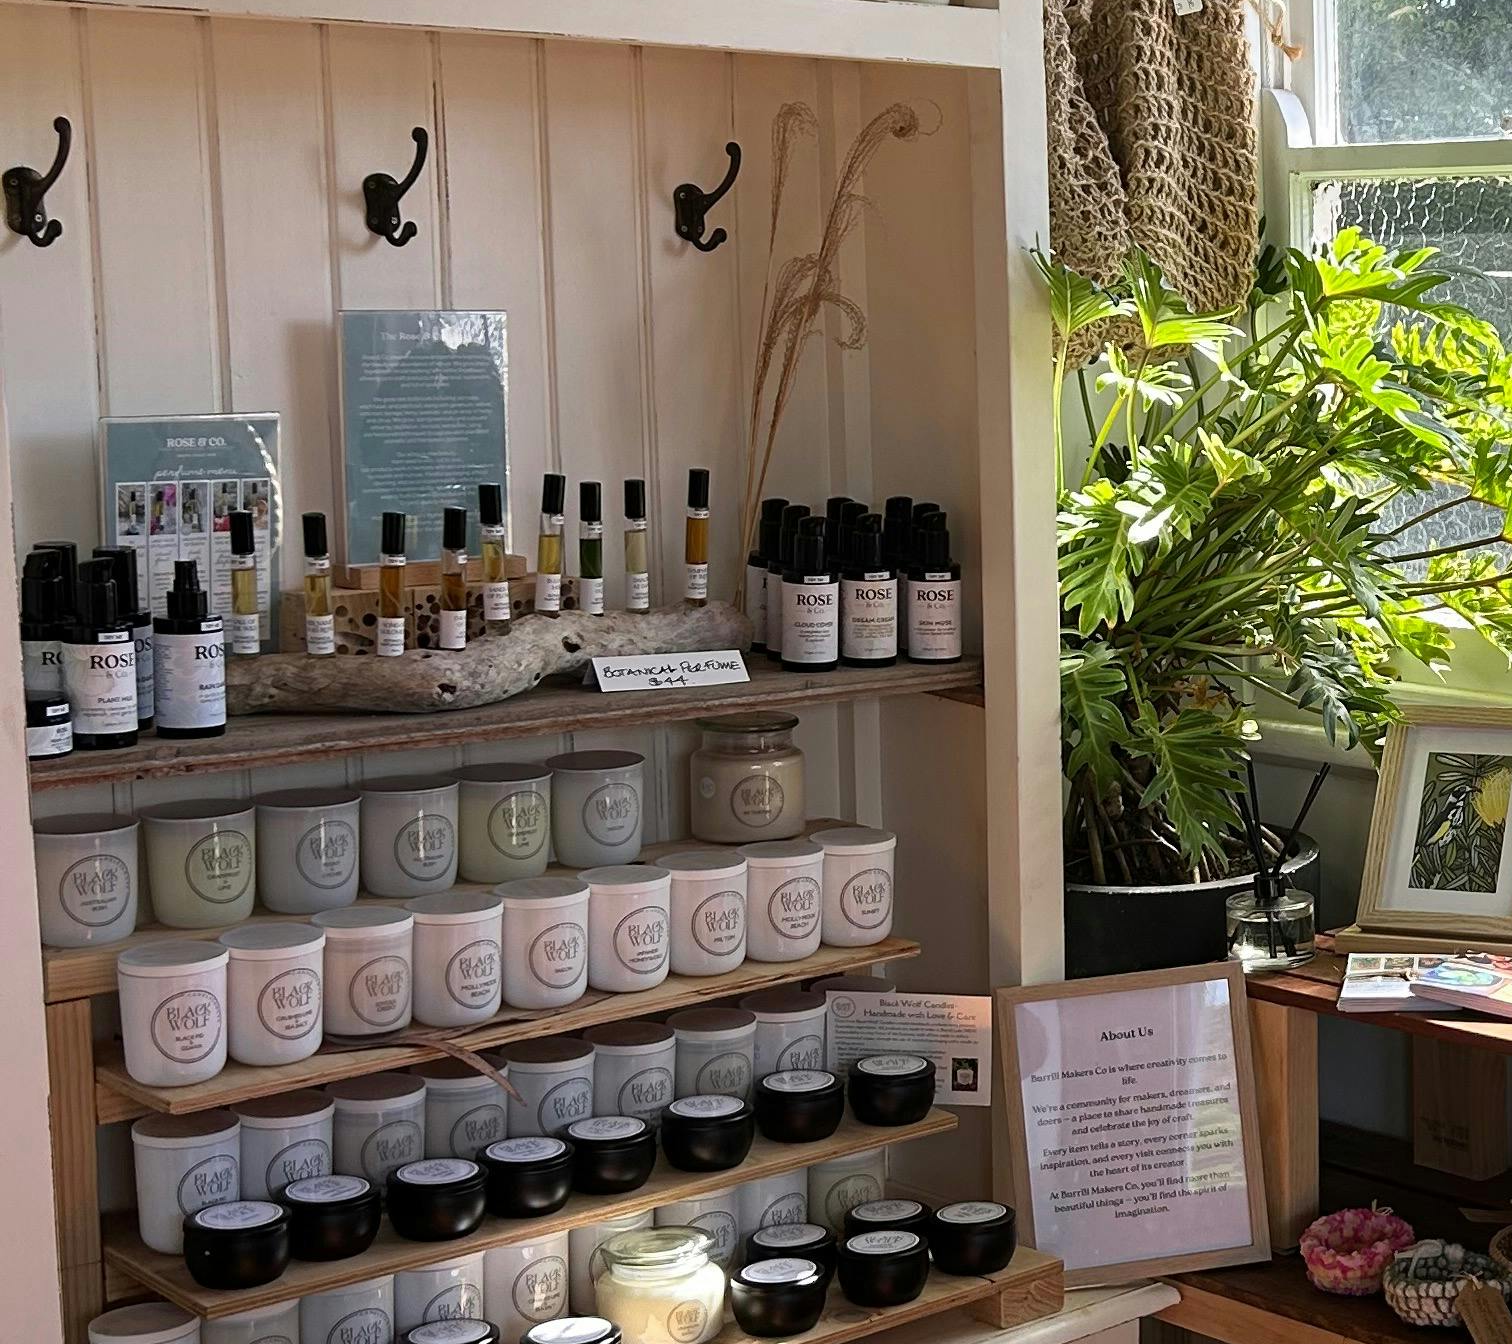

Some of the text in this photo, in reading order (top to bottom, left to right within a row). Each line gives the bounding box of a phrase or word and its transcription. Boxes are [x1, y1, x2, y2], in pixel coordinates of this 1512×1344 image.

[166, 437, 196, 448] ROSE
[209, 436, 227, 447] CO.
[796, 594, 833, 606] ROSE
[855, 588, 892, 601] ROSE
[917, 589, 955, 602] ROSE
[194, 643, 224, 660] ROS
[90, 653, 134, 669] ROSE
[602, 659, 742, 678] BOTANICAL PERFUME
[648, 675, 689, 687] $44
[502, 806, 541, 819] BLACK
[504, 817, 539, 830] WOLF
[202, 845, 243, 859] BLACK
[203, 857, 242, 871] WOLF
[73, 869, 118, 884] BLACK
[75, 880, 116, 896] WOLF
[852, 882, 886, 896] BLACK
[781, 889, 815, 904] BLACK
[854, 893, 884, 905] WOLF
[782, 900, 813, 913] WOLF
[705, 908, 739, 923] BLACK
[628, 920, 664, 935] BLACK
[706, 919, 738, 932] WOLF
[544, 936, 579, 951] BLACK
[629, 934, 663, 947] WOLF
[459, 952, 496, 970] BLACK
[545, 946, 578, 962] WOLF
[365, 970, 403, 986] BLACK
[461, 965, 495, 980] WOLF
[272, 980, 313, 999] BLACK
[367, 984, 402, 998] WOLF
[274, 995, 312, 1009] WOLF
[880, 999, 898, 1007] Black
[901, 1000, 921, 1008] Wolf
[166, 1003, 211, 1020] BLACK
[864, 1008, 905, 1018] Handmade
[927, 1012, 945, 1020] Love
[956, 1012, 976, 1020] Care
[169, 1016, 209, 1031] WOLF
[1100, 1027, 1154, 1042] About Us
[1061, 1067, 1094, 1080] Makers
[1095, 1066, 1107, 1075] Co
[1108, 1065, 1116, 1074] is
[1118, 1062, 1145, 1073] where
[1146, 1057, 1187, 1069] creativity
[1188, 1055, 1216, 1064] comes
[1218, 1053, 1227, 1061] to
[632, 1078, 667, 1094] BLACK
[553, 1090, 589, 1107] BLACK
[633, 1090, 665, 1105] WOLF
[1032, 1101, 1059, 1114] We're
[1066, 1096, 1117, 1110] community
[1118, 1094, 1130, 1105] for
[1133, 1090, 1168, 1102] makers,
[1214, 1082, 1231, 1092] and
[554, 1105, 586, 1120] WOLF
[1037, 1116, 1062, 1127] doers
[1079, 1111, 1102, 1124] place
[1103, 1110, 1112, 1119] to
[1114, 1106, 1139, 1118] share
[1140, 1100, 1186, 1113] handmade
[1188, 1096, 1229, 1108] treasures
[465, 1117, 498, 1133] BLACK
[1072, 1125, 1089, 1136] and
[1090, 1121, 1130, 1134] celebrate
[1132, 1119, 1146, 1129] the
[1147, 1117, 1160, 1128] joy
[1162, 1115, 1171, 1125] of
[466, 1127, 498, 1142] WOLF
[1043, 1147, 1067, 1158] Every
[1068, 1144, 1089, 1154] item
[1090, 1141, 1109, 1151] tells
[1144, 1134, 1168, 1146] every
[1169, 1131, 1198, 1143] corner
[1199, 1126, 1229, 1138] sparks
[376, 1134, 414, 1151] BLACK
[283, 1153, 323, 1172] BLACK
[1040, 1139, 1234, 1171] inspiration, and every visit connects you with
[194, 1167, 233, 1185] BLACK
[1089, 1168, 1104, 1178] the
[1105, 1166, 1129, 1177] heart
[1130, 1163, 1139, 1173] of
[1141, 1162, 1152, 1171] its
[195, 1181, 231, 1196] WOLF
[1049, 1191, 1060, 1201] At
[1061, 1187, 1090, 1199] Burrill
[1091, 1183, 1124, 1195] Makers
[1166, 1175, 1184, 1186] find
[1185, 1173, 1208, 1183] more
[1209, 1170, 1230, 1181] than
[1054, 1199, 1095, 1213] beautiful
[1096, 1196, 1124, 1208] things
[1159, 1189, 1177, 1200] find
[1178, 1187, 1193, 1197] the
[1193, 1185, 1217, 1197] spirit
[1218, 1183, 1228, 1193] of
[341, 1320, 382, 1337] BLACK
